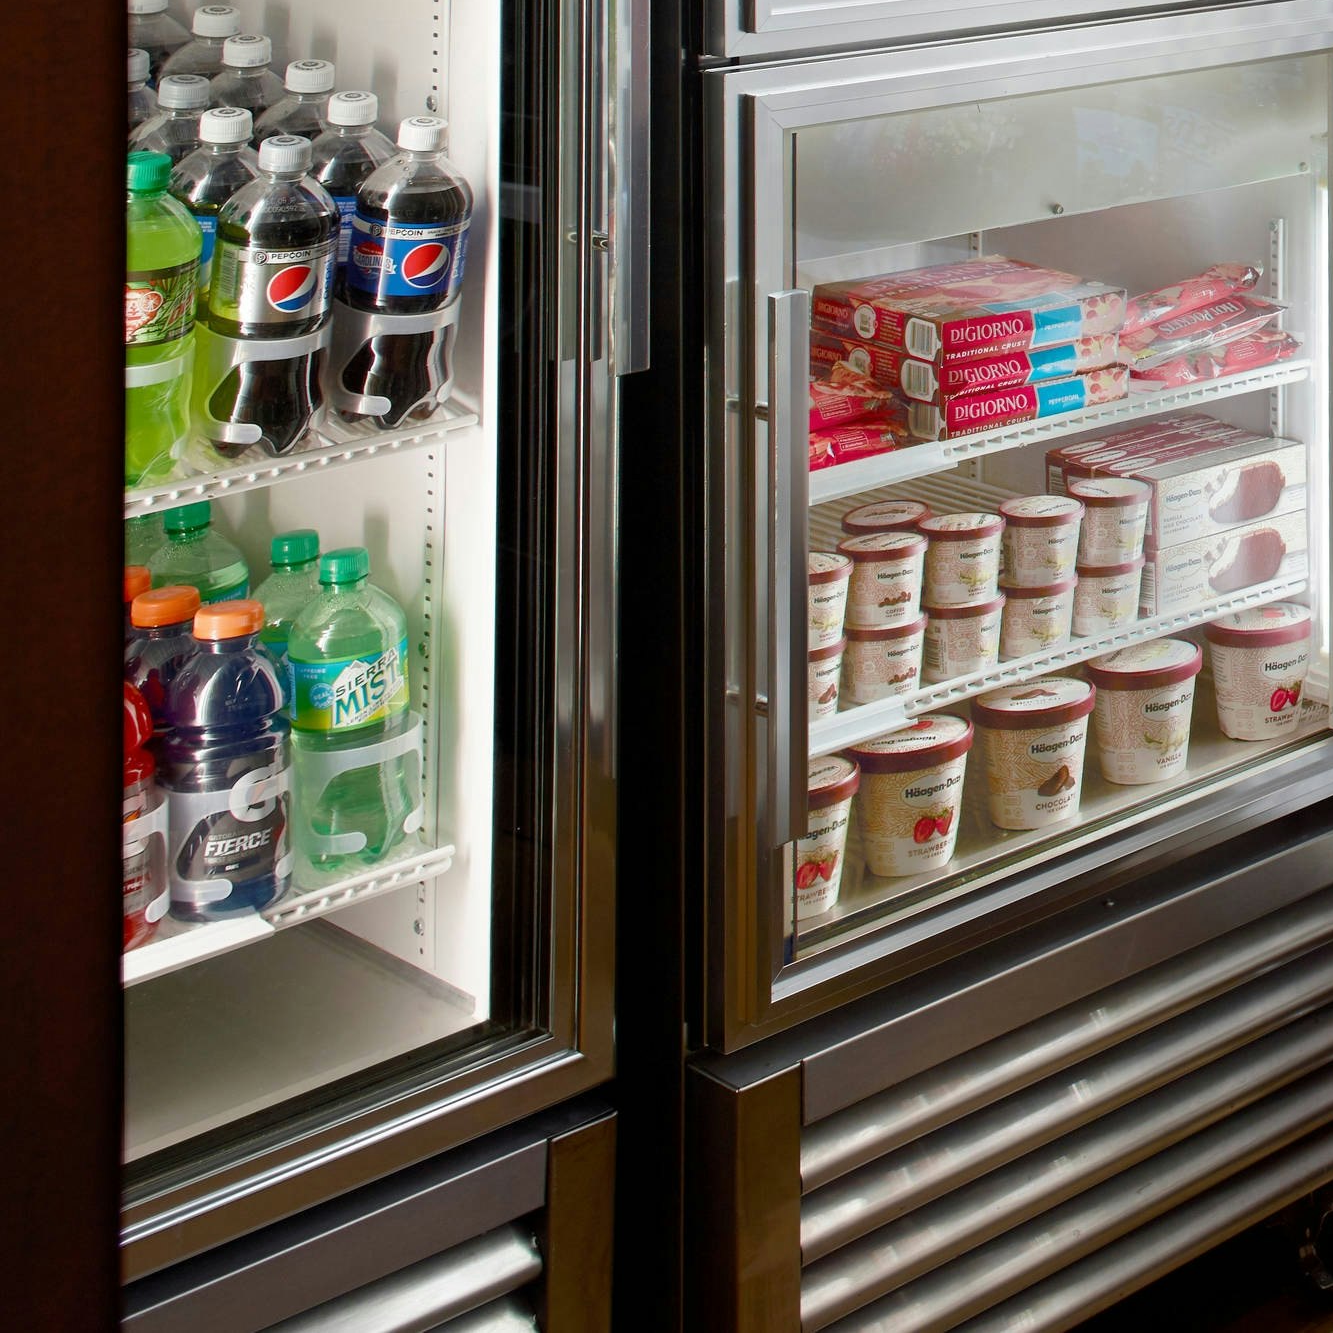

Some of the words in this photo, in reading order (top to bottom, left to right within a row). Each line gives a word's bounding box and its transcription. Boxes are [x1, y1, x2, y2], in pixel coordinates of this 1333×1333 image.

[271, 250, 311, 260] PEPCOIN
[1212, 302, 1239, 314] HOT
[951, 318, 1023, 342] DIGIORNO
[946, 346, 998, 360] TRADITIONAL
[1001, 340, 1026, 351] CRUST
[949, 359, 1020, 383] DIGIORNO
[998, 378, 1022, 388] CRUST
[955, 394, 1028, 419] DIGIORNO
[951, 422, 1003, 438] TRADITIONAL
[1007, 416, 1031, 427] CRUST
[336, 648, 397, 697] SIERRA
[336, 663, 398, 725] MIST
[1156, 753, 1181, 765] VANILLA
[906, 776, 960, 798] Häagen-Dazs
[205, 827, 271, 857] FIERCE
